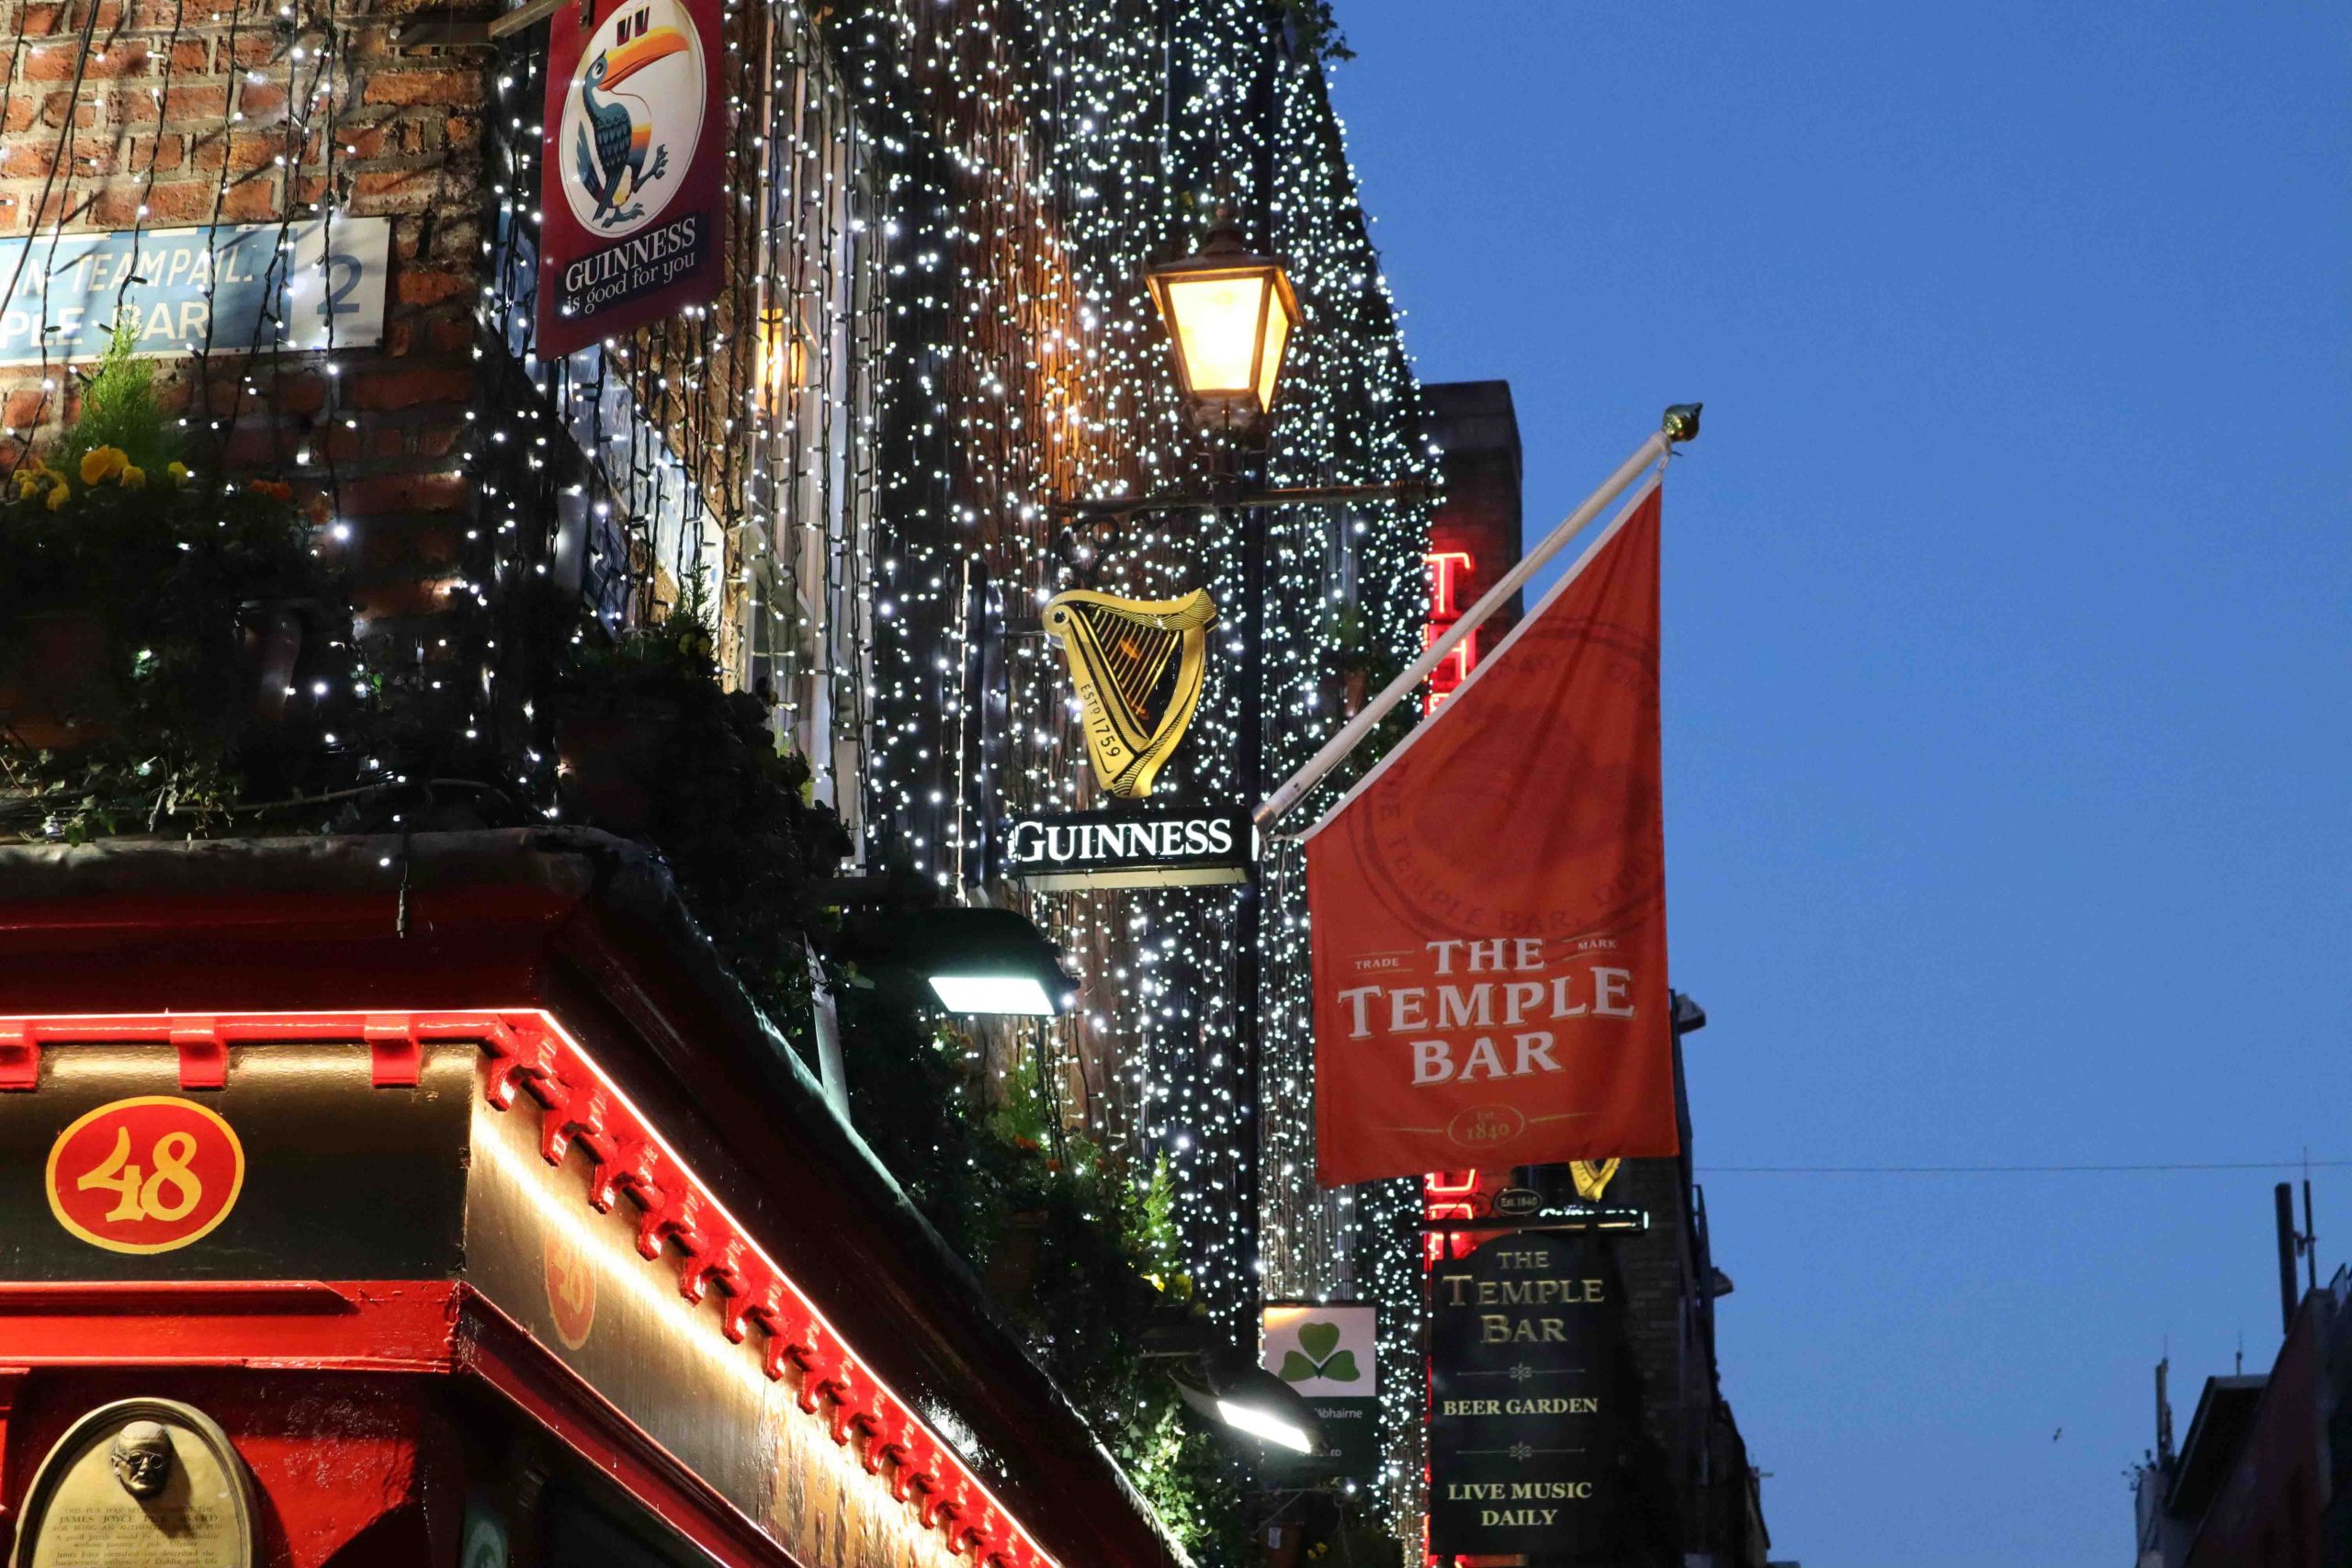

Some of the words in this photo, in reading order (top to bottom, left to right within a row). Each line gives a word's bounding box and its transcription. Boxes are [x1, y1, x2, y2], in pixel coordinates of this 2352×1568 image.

[566, 216, 695, 292] GUINNESS
[316, 254, 362, 315] 2
[566, 295, 581, 312] is
[584, 274, 627, 314] good
[632, 264, 659, 288] for
[663, 251, 695, 284] you
[110, 301, 210, 342] BAR
[1092, 718, 1121, 757] 1759
[1007, 818, 1233, 863] GUINNESS
[1354, 956, 1400, 971] TRADE
[1426, 938, 1546, 977] THE
[1577, 939, 1617, 951] MARK
[1338, 966, 1637, 1040] TEMPLE
[1410, 1031, 1565, 1088] BAR
[1465, 1123, 1510, 1141] 1840
[77, 1125, 202, 1223] 48
[1497, 1251, 1550, 1269] THE
[1442, 1275, 1606, 1306] TEMPLE
[1480, 1314, 1568, 1344] BAR
[1442, 1400, 1501, 1416] BEER
[1505, 1398, 1599, 1415] GARDEN
[1448, 1483, 1506, 1500] LIVE
[1510, 1483, 1593, 1499] MUSIC
[1481, 1509, 1559, 1526] DAILY
